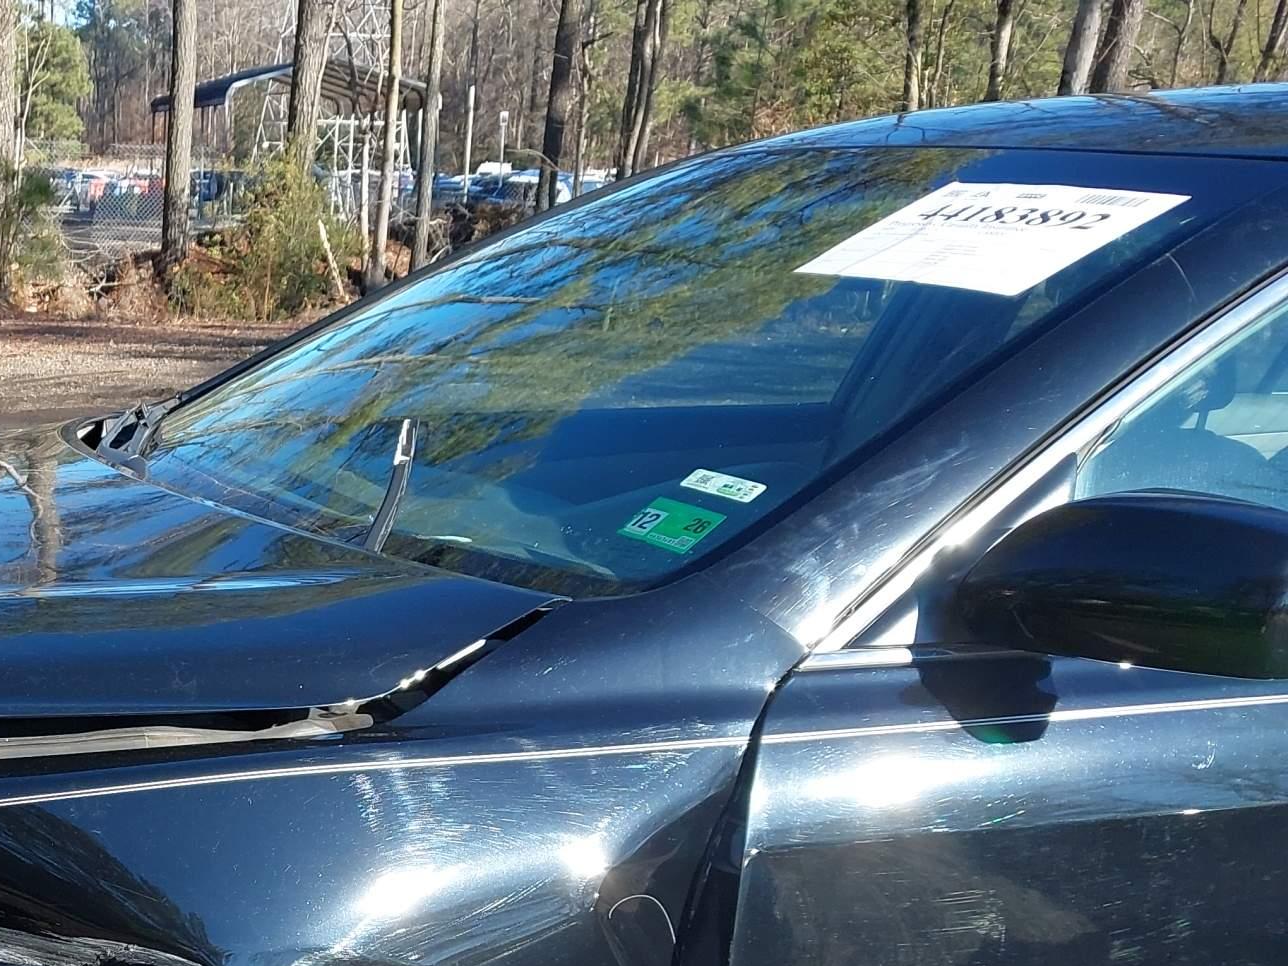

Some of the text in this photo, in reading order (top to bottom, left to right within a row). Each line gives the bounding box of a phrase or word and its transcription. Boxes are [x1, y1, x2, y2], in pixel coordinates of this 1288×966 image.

[918, 203, 1111, 230] 44183892
[632, 511, 662, 530] 12
[683, 517, 712, 534] 26
